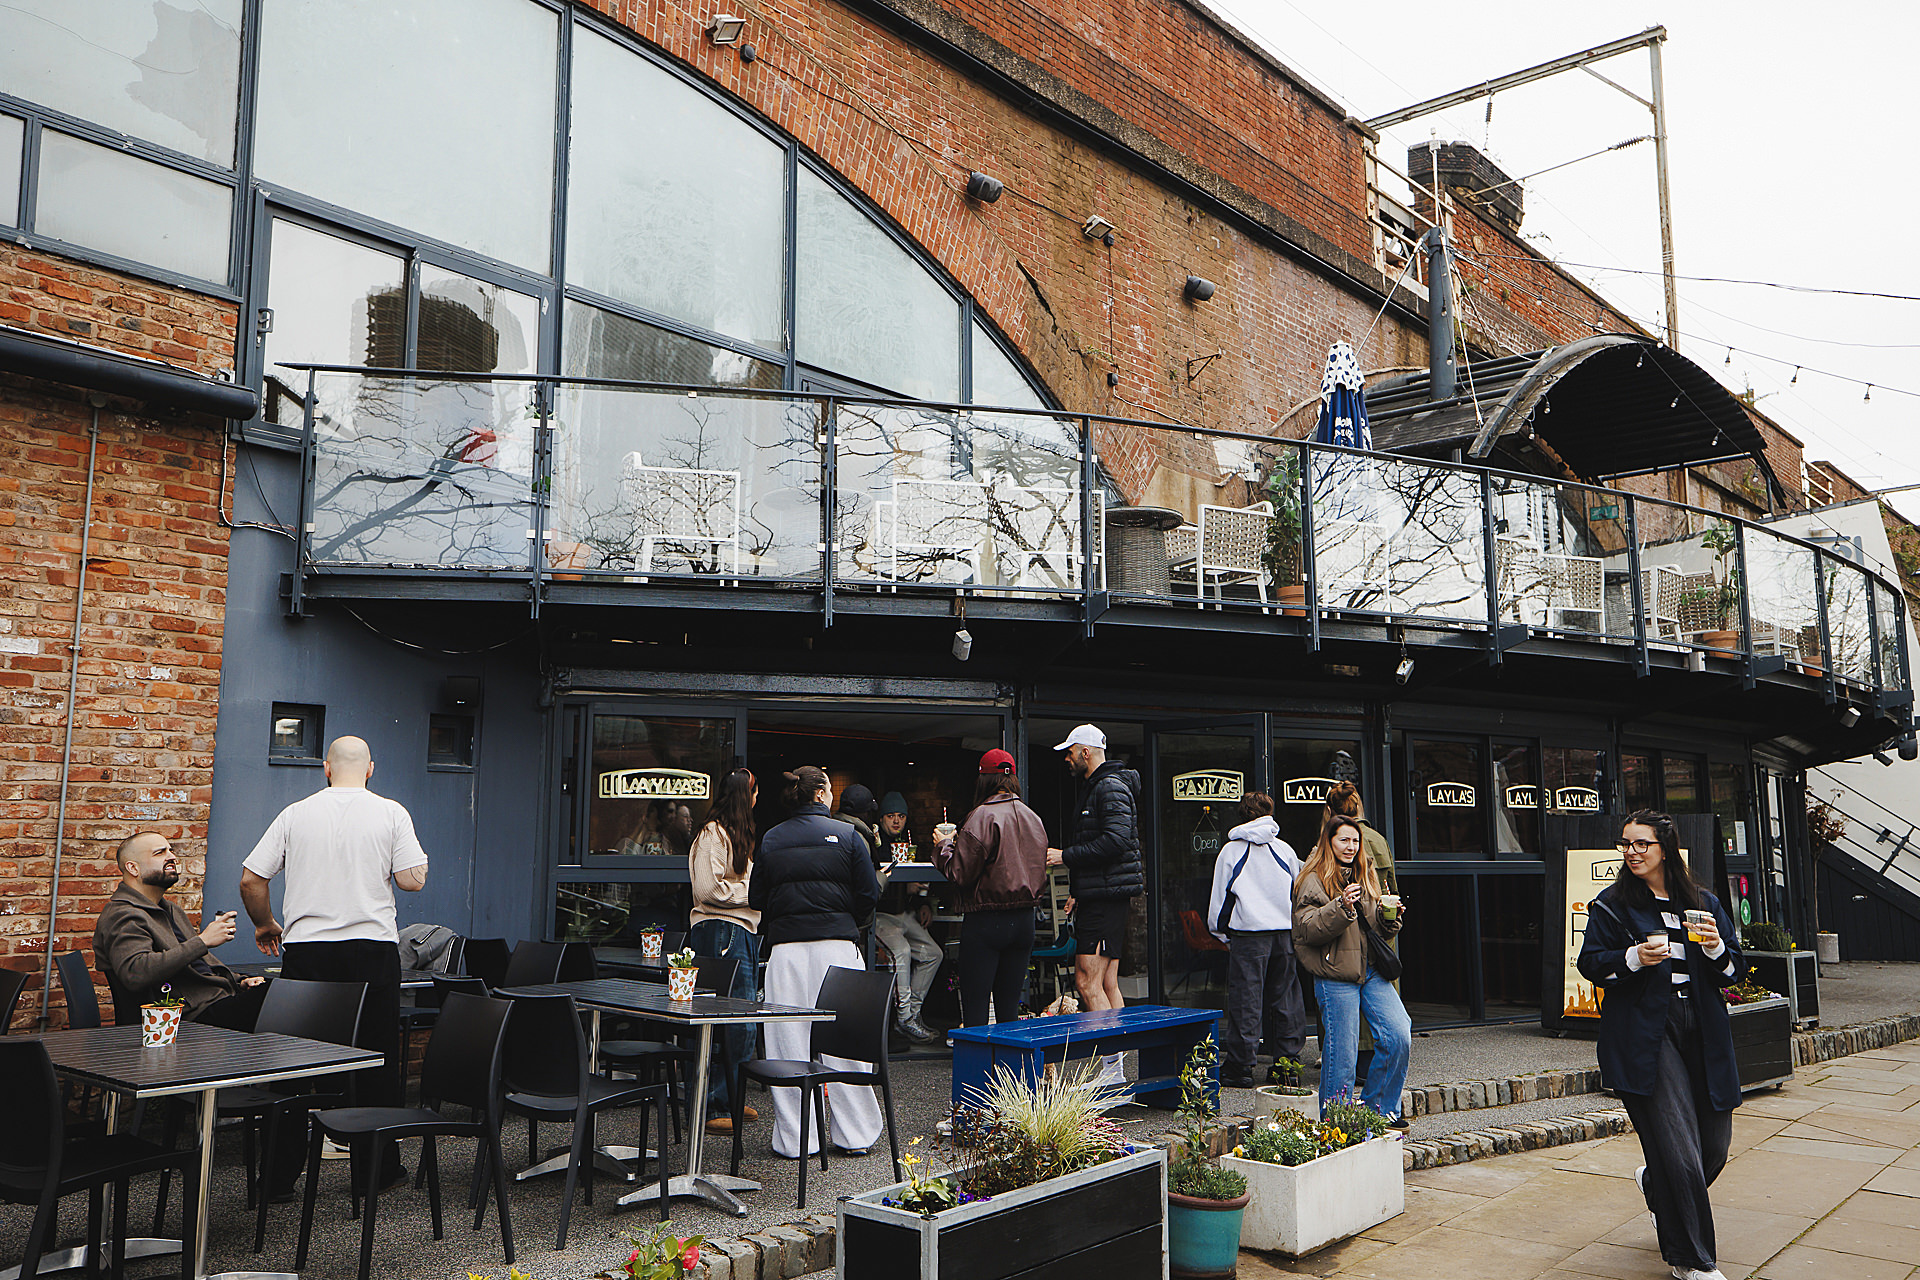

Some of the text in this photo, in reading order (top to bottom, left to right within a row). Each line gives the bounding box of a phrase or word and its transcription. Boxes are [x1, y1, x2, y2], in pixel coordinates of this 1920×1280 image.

[1429, 789, 1473, 805] LAYLA'S
[1558, 793, 1597, 808] LAYLA'S
[1193, 834, 1219, 853] Open
